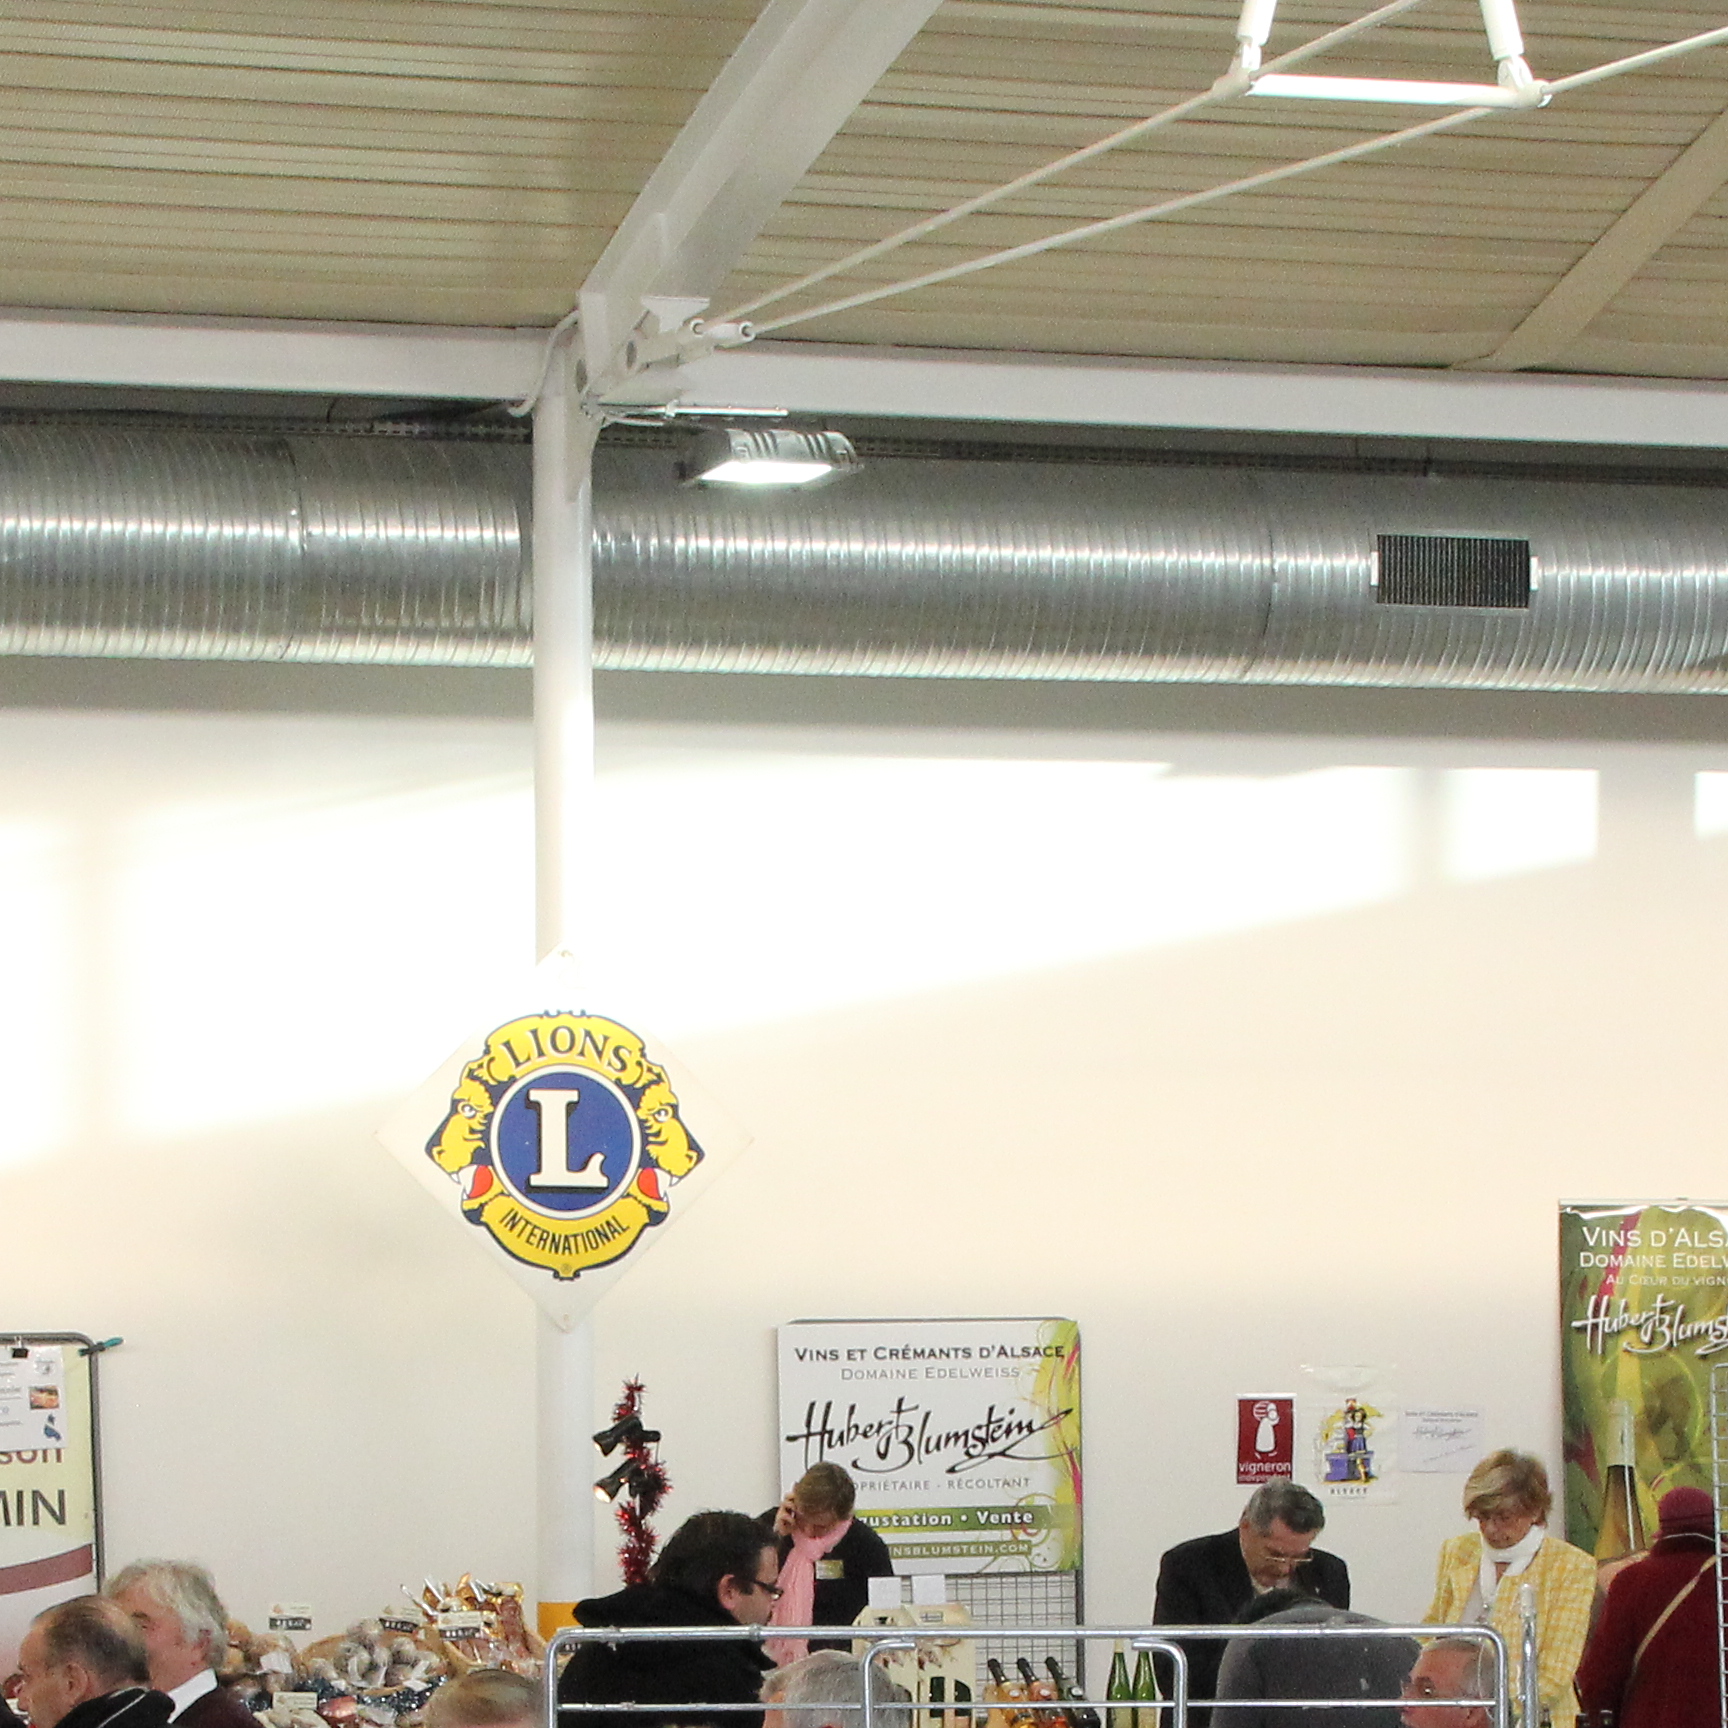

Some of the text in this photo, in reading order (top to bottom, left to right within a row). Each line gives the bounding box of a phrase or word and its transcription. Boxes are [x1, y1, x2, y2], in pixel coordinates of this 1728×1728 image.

[502, 1026, 631, 1072] LIONS
[528, 1089, 609, 1190] L
[499, 1208, 631, 1256] INTERNATIONAL
[1239, 1461, 1291, 1474] vigneron
[948, 1477, 1031, 1490] RÉCOLTANT
[860, 1510, 1034, 1530] gustation Vente
[889, 1543, 1029, 1557] INSBLUMSTEIN.COM
